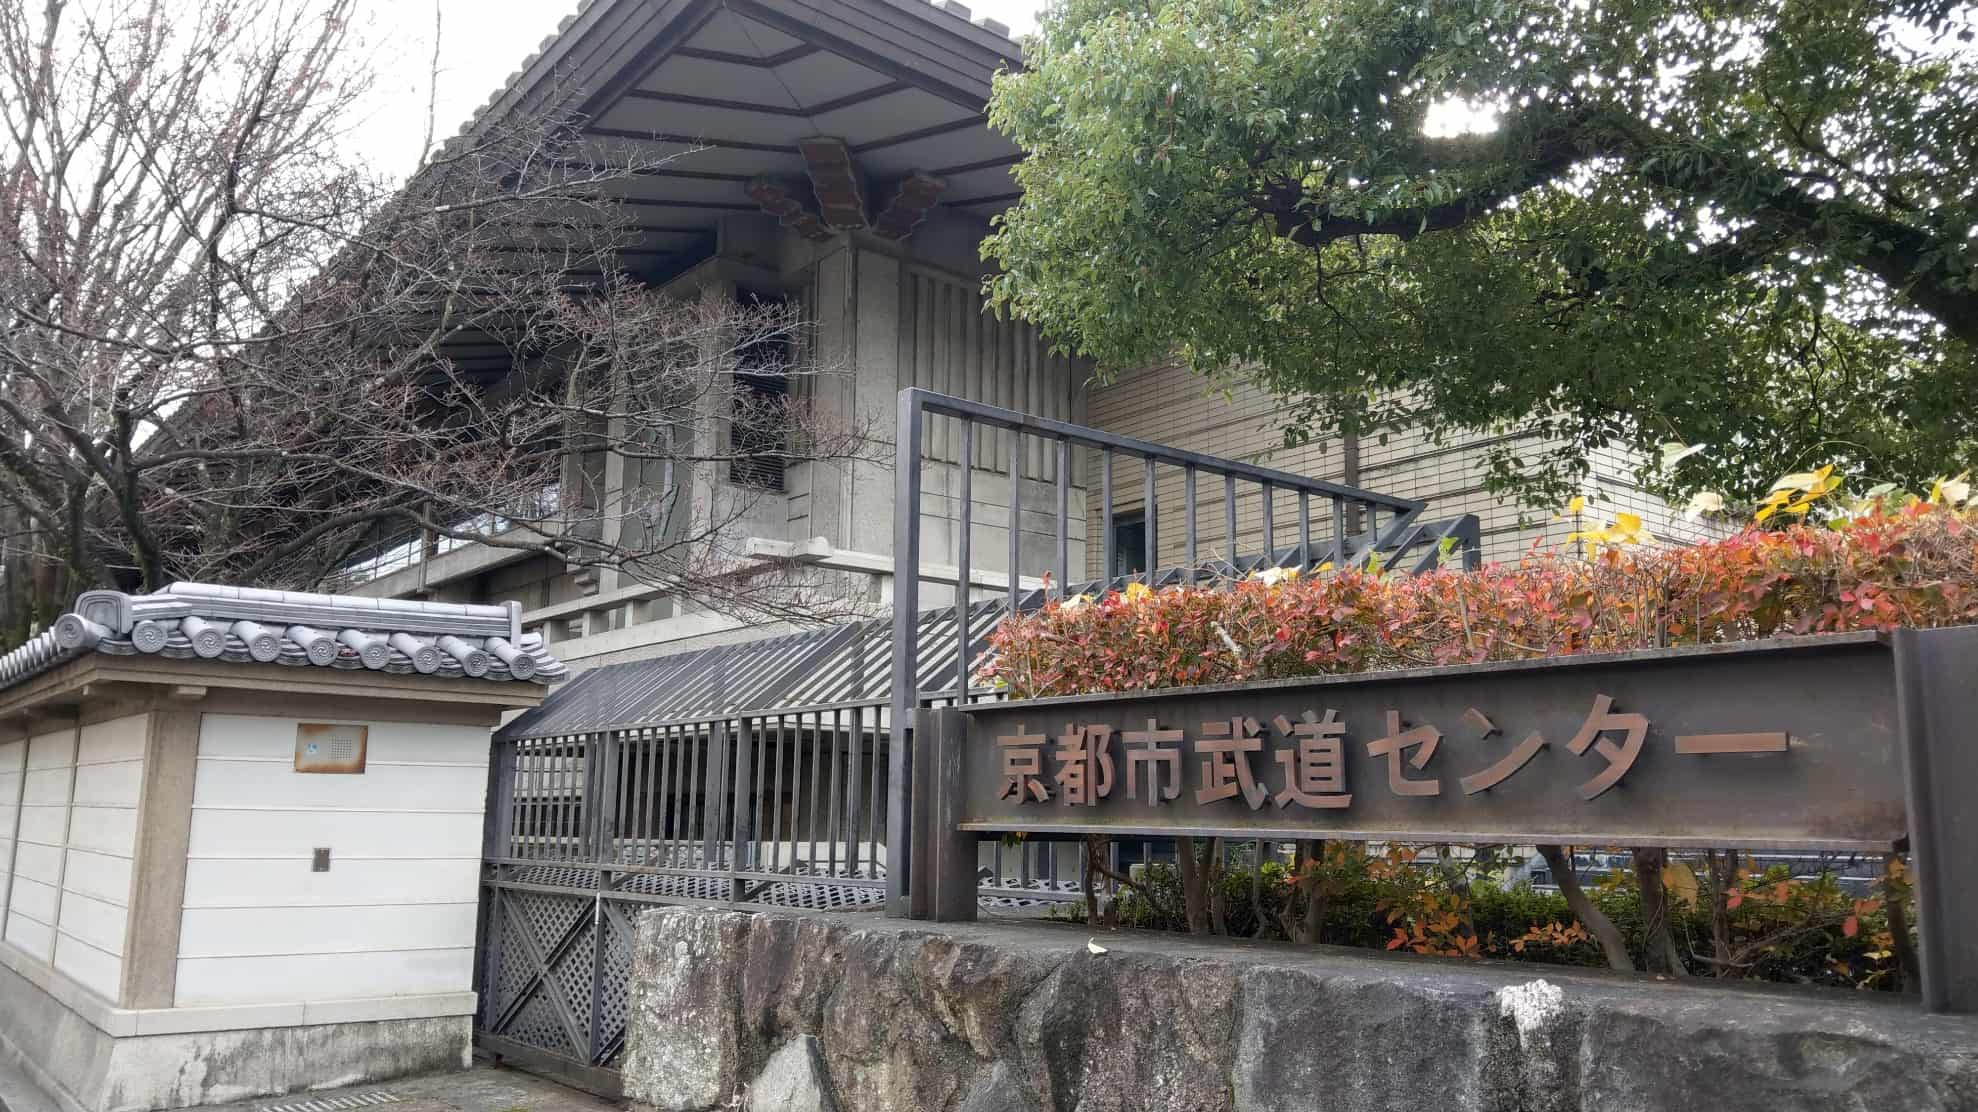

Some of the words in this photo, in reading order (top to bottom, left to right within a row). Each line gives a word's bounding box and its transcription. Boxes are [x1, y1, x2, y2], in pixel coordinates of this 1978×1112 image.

[997, 694, 1789, 810] 京都市武道センター
